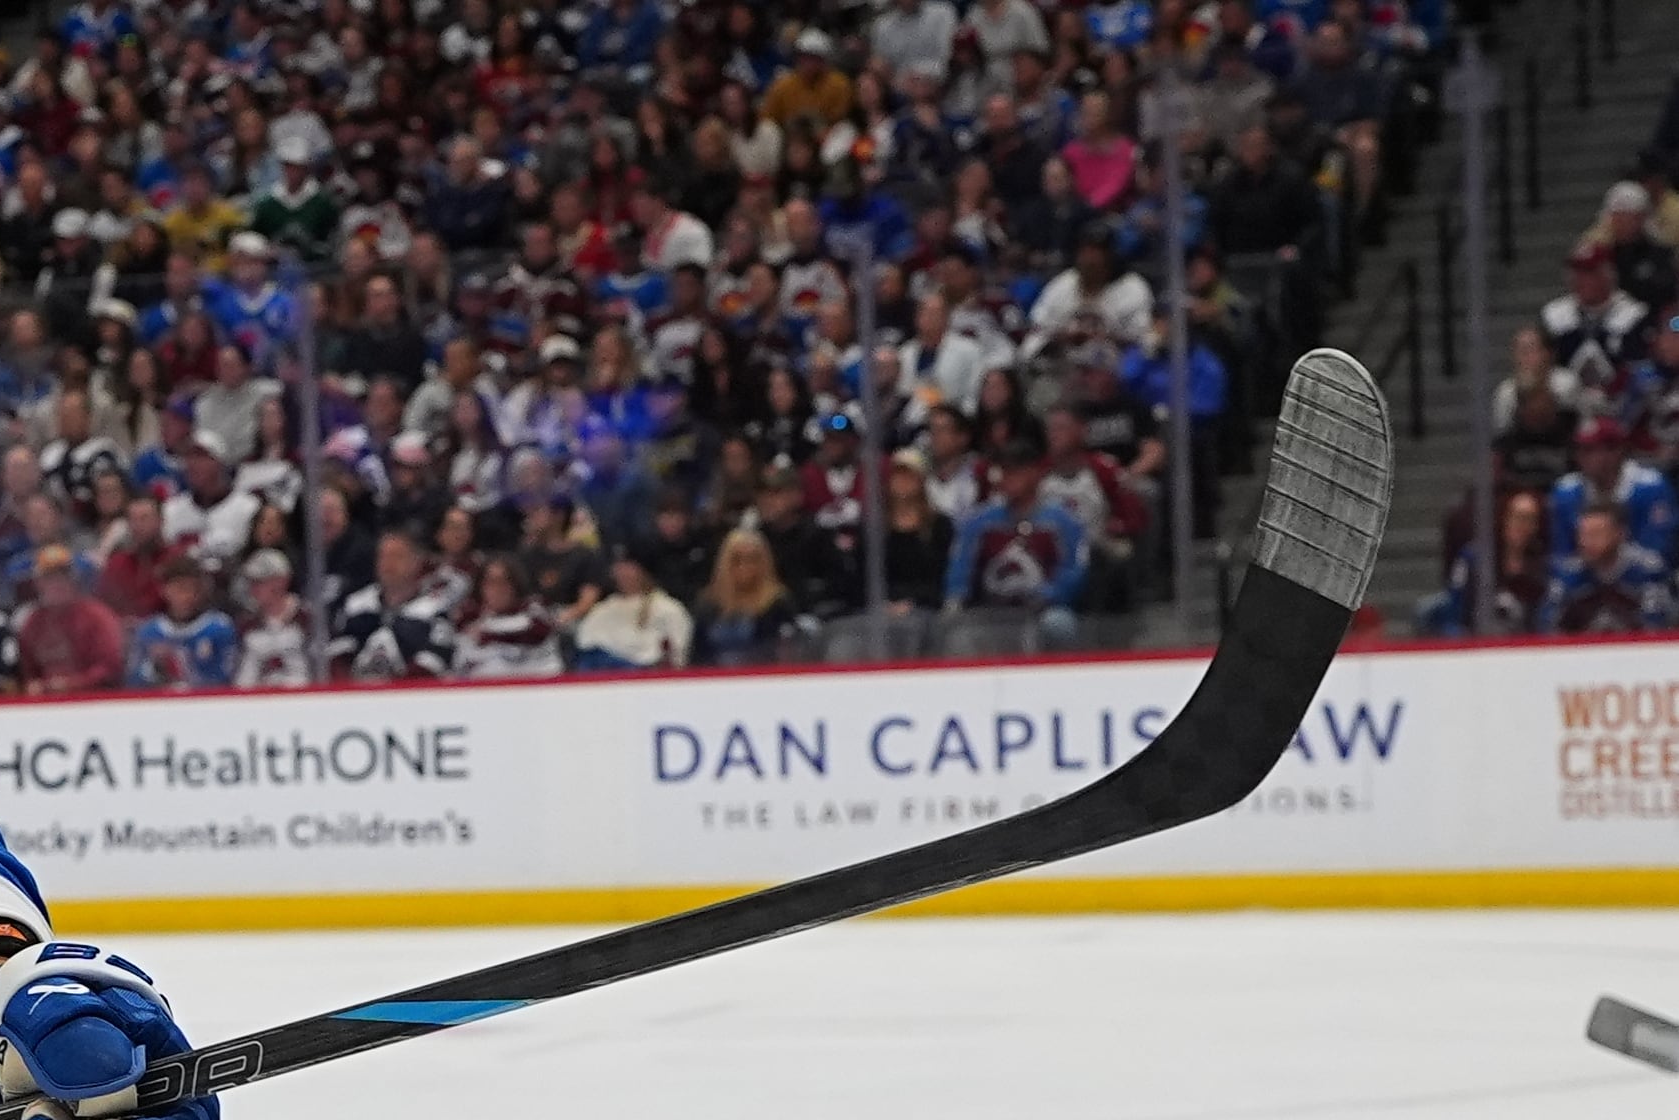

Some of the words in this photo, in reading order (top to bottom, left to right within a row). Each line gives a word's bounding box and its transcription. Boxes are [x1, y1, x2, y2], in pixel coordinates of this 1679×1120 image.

[133, 726, 469, 788] HealthONE
[654, 719, 827, 784] DAN
[1, 820, 95, 862] ocky
[103, 814, 278, 850] Mountain
[287, 808, 475, 848] Children's
[700, 802, 772, 830] THE
[794, 799, 879, 829] LAW
[900, 793, 1002, 824] FIRM
